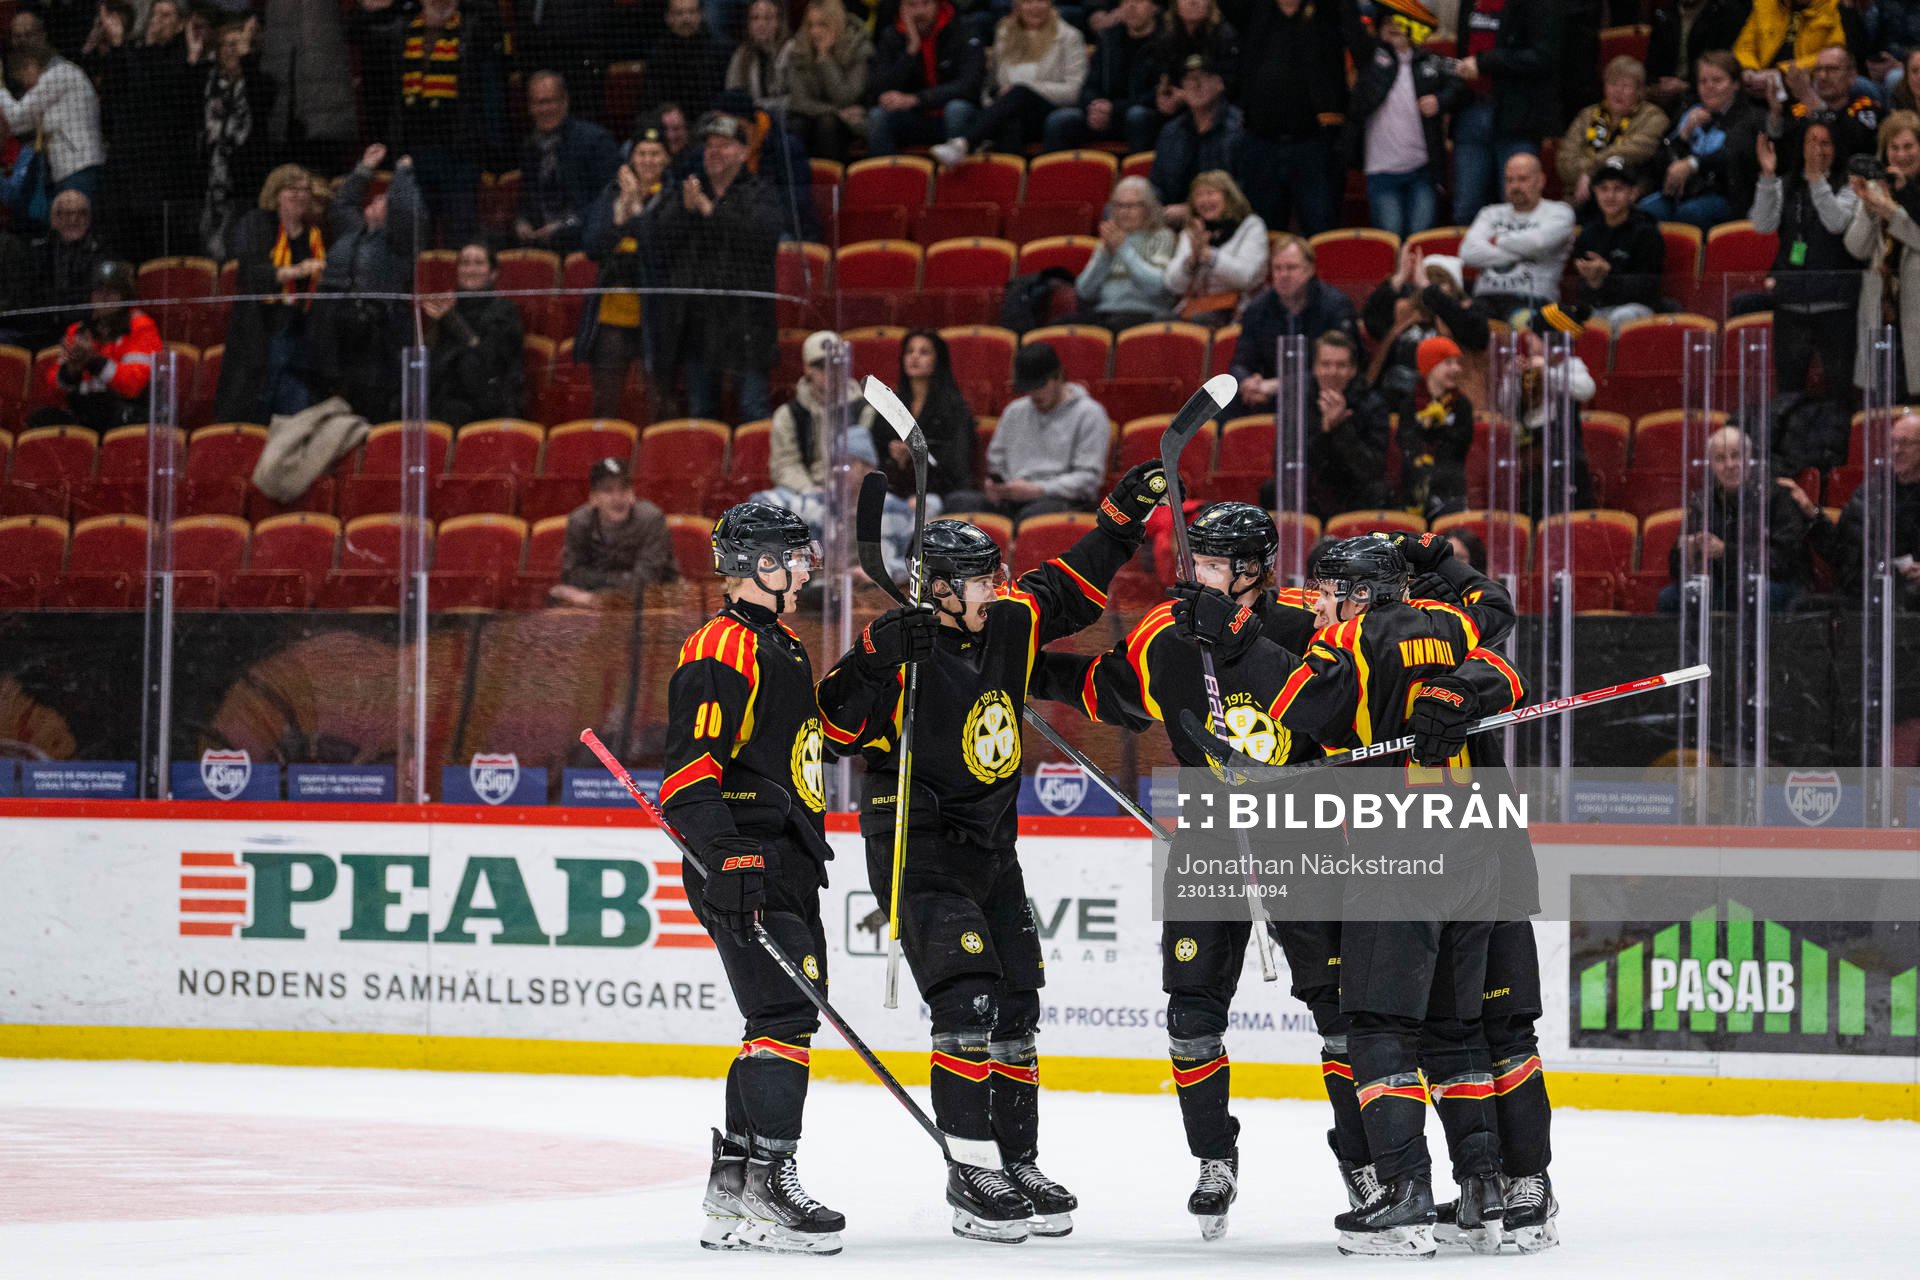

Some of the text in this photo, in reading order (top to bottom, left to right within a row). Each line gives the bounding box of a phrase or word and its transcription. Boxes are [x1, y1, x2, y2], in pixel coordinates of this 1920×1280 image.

[980, 690, 999, 706] 1912
[1224, 692, 1252, 706] 1912
[1235, 714, 1247, 728] B
[1255, 739, 1265, 753] F
[1351, 735, 1416, 762] BAUE
[721, 791, 757, 800] AUER
[872, 794, 896, 805] BAUE
[1791, 786, 1834, 817] 4Sign
[722, 854, 765, 871] BAU
[241, 851, 653, 948] PEAB
[178, 969, 716, 1010] NORDENS SAMHÄLLSBYGGARE
[1651, 959, 1795, 1014] PASAB
[1065, 1008, 1150, 1028] PROCESS
